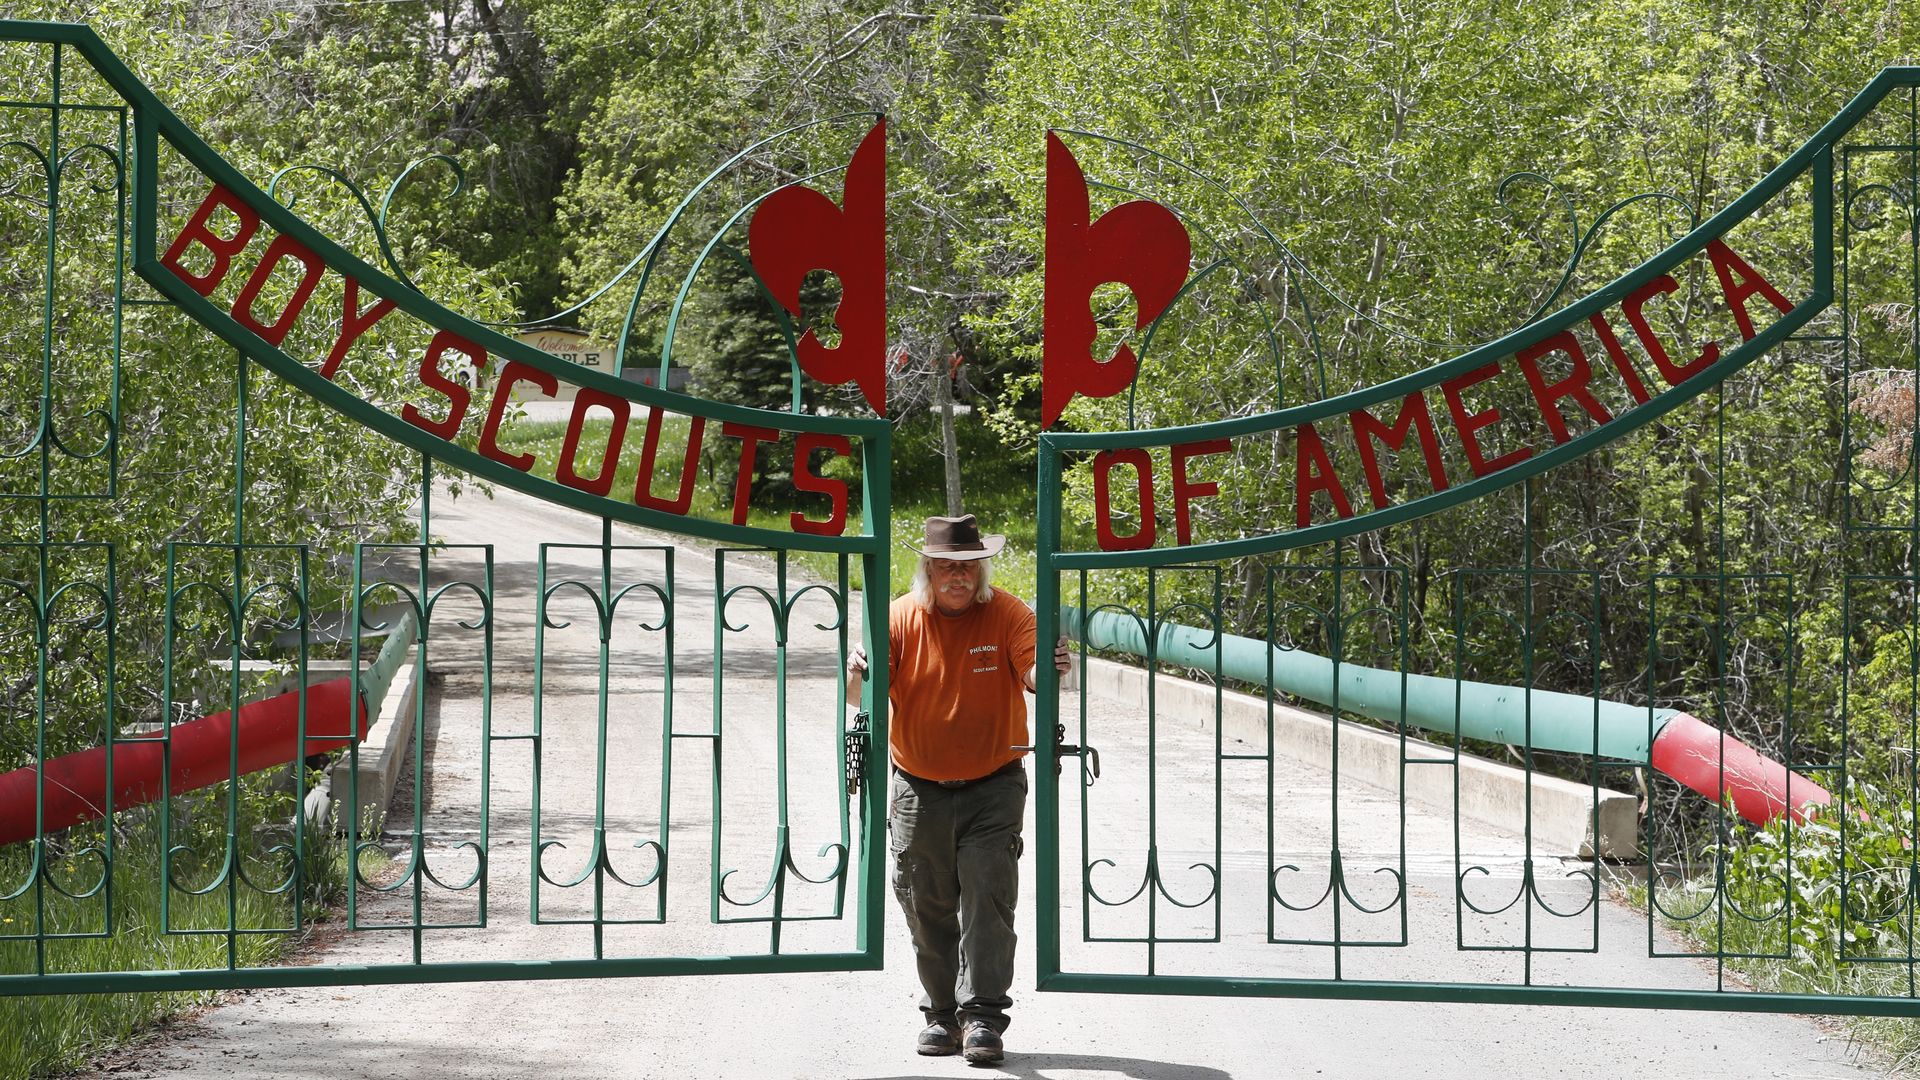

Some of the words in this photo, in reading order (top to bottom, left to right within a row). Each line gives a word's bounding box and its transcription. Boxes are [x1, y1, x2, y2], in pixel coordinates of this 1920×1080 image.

[160, 183, 398, 380] BOY
[402, 329, 851, 537] SCOUTS
[1094, 438, 1232, 552] OF
[1297, 238, 1795, 528] AMERICA
[969, 645, 998, 655] PHILMONT
